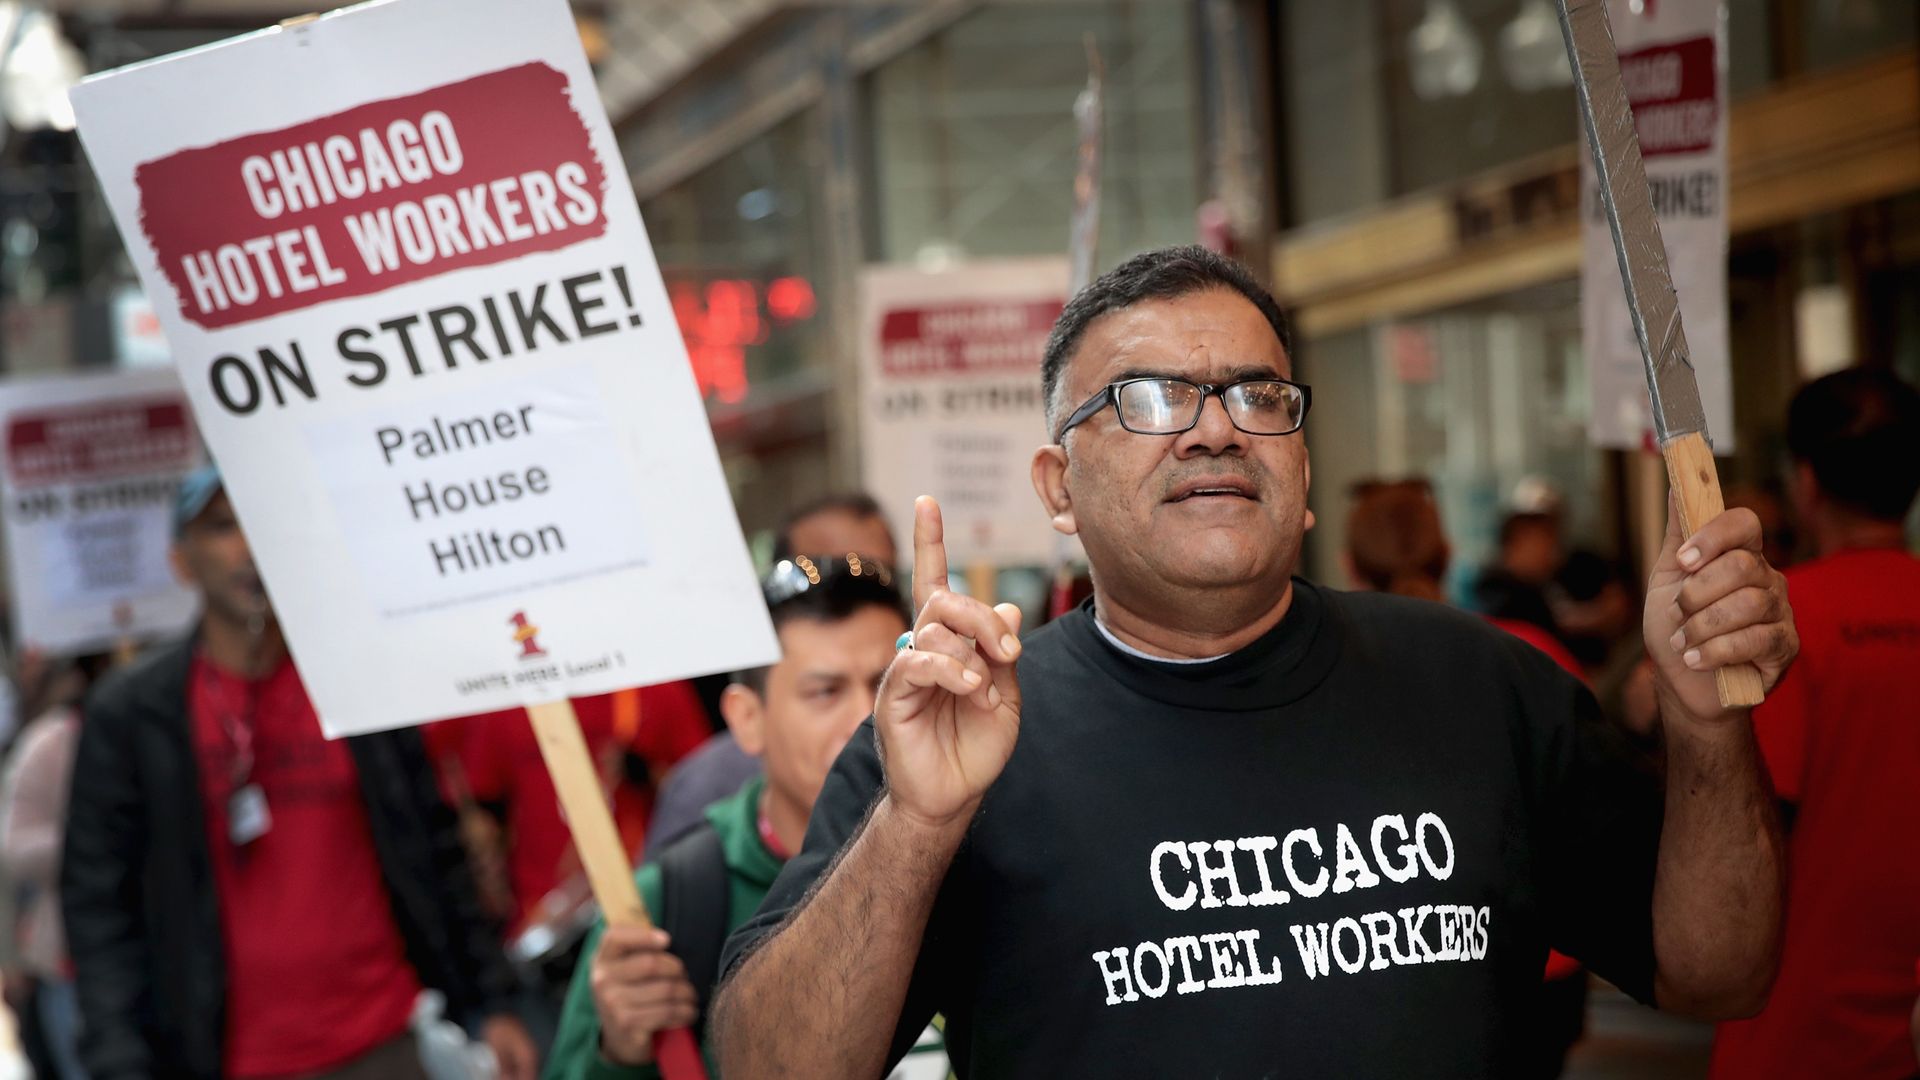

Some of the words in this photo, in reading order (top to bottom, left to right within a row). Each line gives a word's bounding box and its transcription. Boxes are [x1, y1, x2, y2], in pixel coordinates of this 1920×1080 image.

[241, 110, 465, 219] CHICAGO
[182, 225, 347, 314] HOTEL
[342, 161, 599, 275] WORKERS
[209, 341, 318, 415] ON
[336, 266, 642, 388] STRIKE!
[375, 402, 536, 466] Palmer
[404, 465, 550, 521] House
[429, 523, 566, 576] Hilton
[455, 671, 510, 697] UNITE
[514, 664, 562, 686] HERE
[563, 655, 612, 679] Local
[1149, 811, 1455, 912] CHICAGO
[1092, 928, 1283, 1006] HOTEL
[1289, 903, 1491, 981] WORKERS
